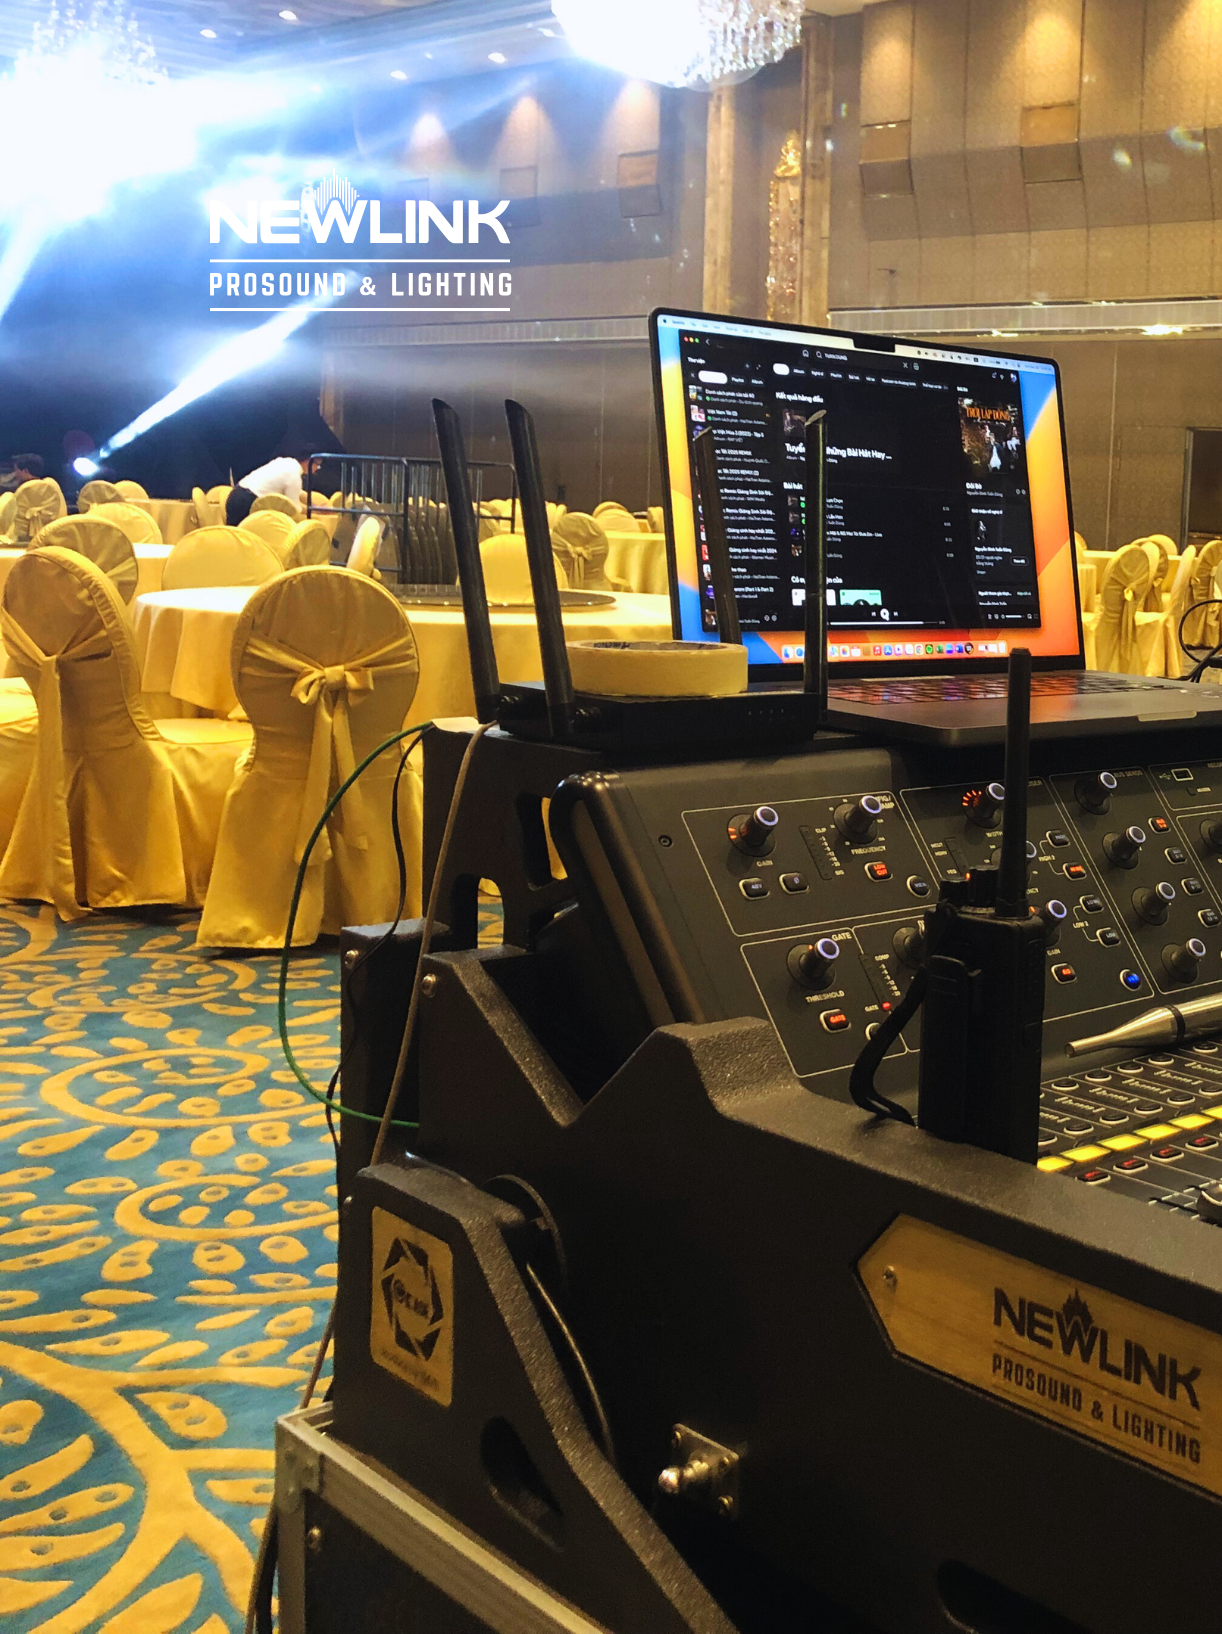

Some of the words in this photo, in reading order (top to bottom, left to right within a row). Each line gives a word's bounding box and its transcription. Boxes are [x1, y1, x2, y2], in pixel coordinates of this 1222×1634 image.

[847, 448, 858, 456] Bài
[859, 449, 871, 458] Hát
[872, 450, 885, 460] Hay
[851, 845, 886, 855] FREQUENCY
[832, 932, 852, 941] GATE
[805, 990, 845, 1003] THRESHOLD
[865, 1004, 879, 1012] GATE
[830, 1014, 846, 1023] GATE
[994, 1287, 1202, 1410] NEWLINK
[992, 1353, 1082, 1412] PROSOUND
[1091, 1399, 1104, 1423] &
[1112, 1404, 1201, 1463] LIGHTING
